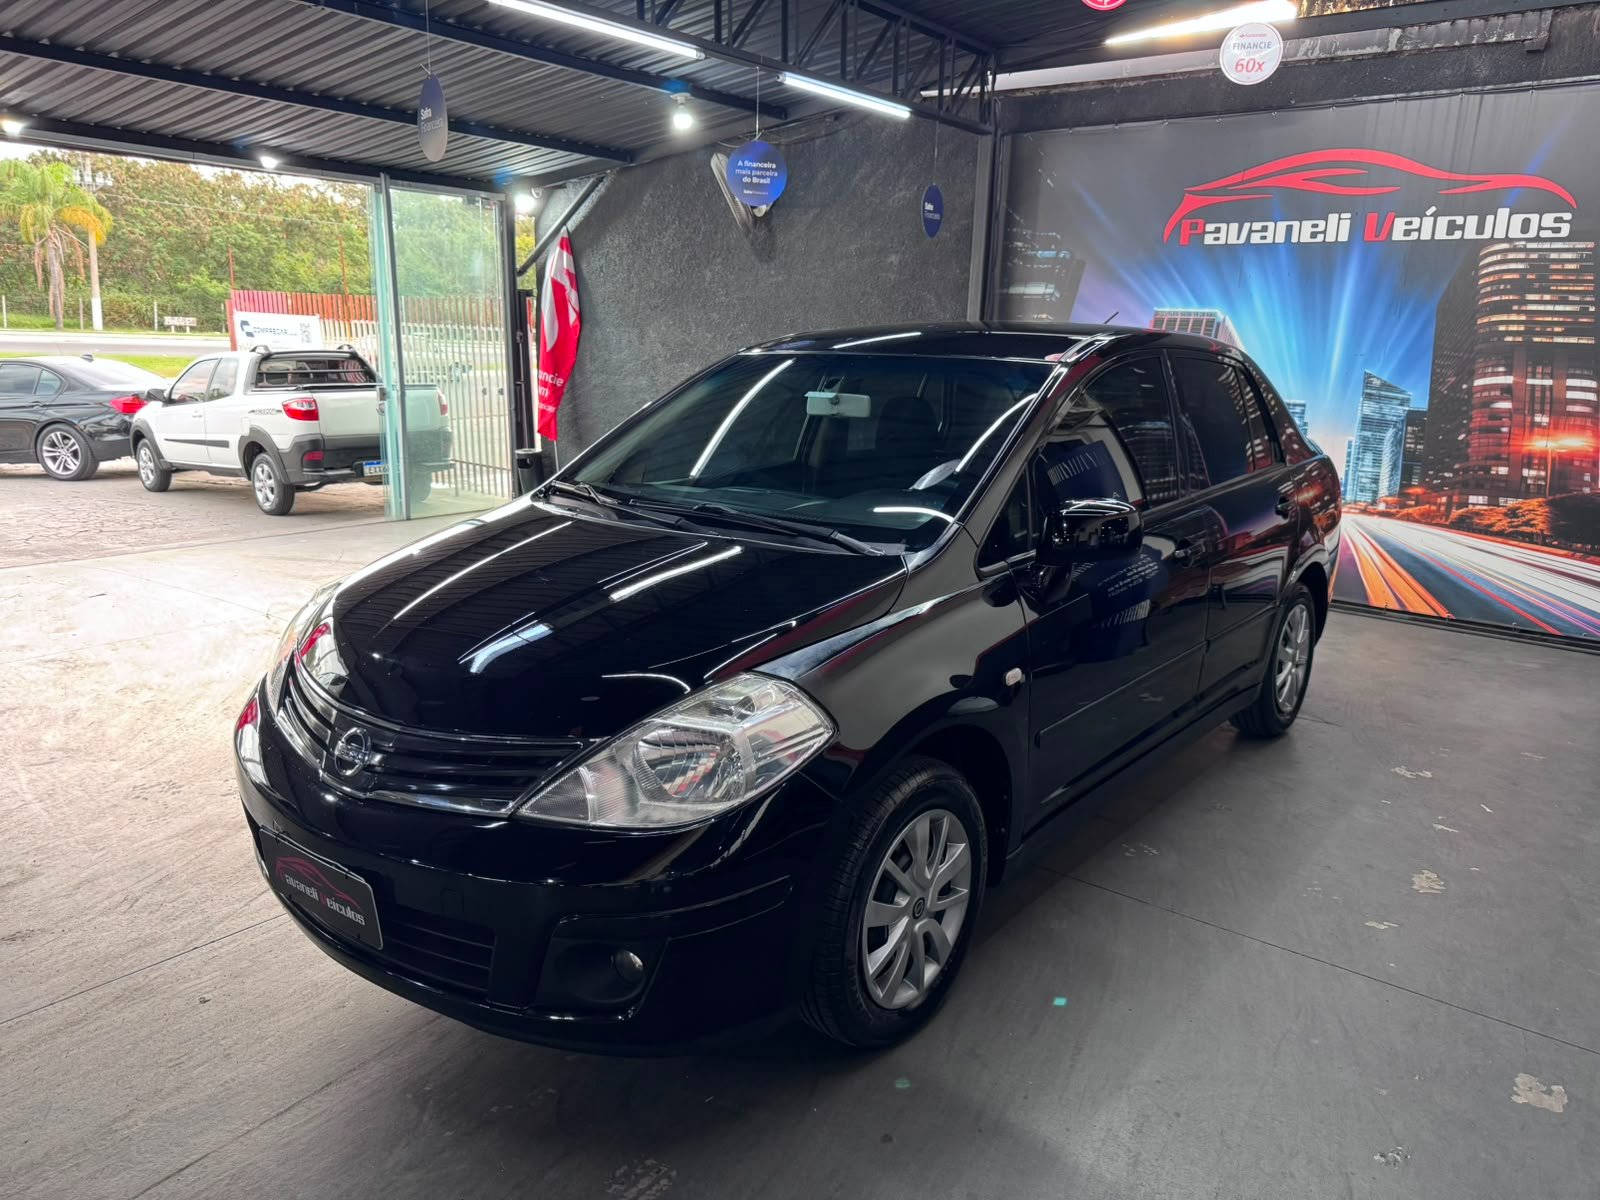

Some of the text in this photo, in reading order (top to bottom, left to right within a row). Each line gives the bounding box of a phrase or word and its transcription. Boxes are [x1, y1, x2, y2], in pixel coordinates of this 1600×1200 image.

[1232, 41, 1273, 50] FINANCIE
[1234, 58, 1265, 73] 60x
[744, 160, 776, 169] financeira
[752, 169, 778, 177] parceira
[1178, 205, 1573, 246] Pavaneli Veículos
